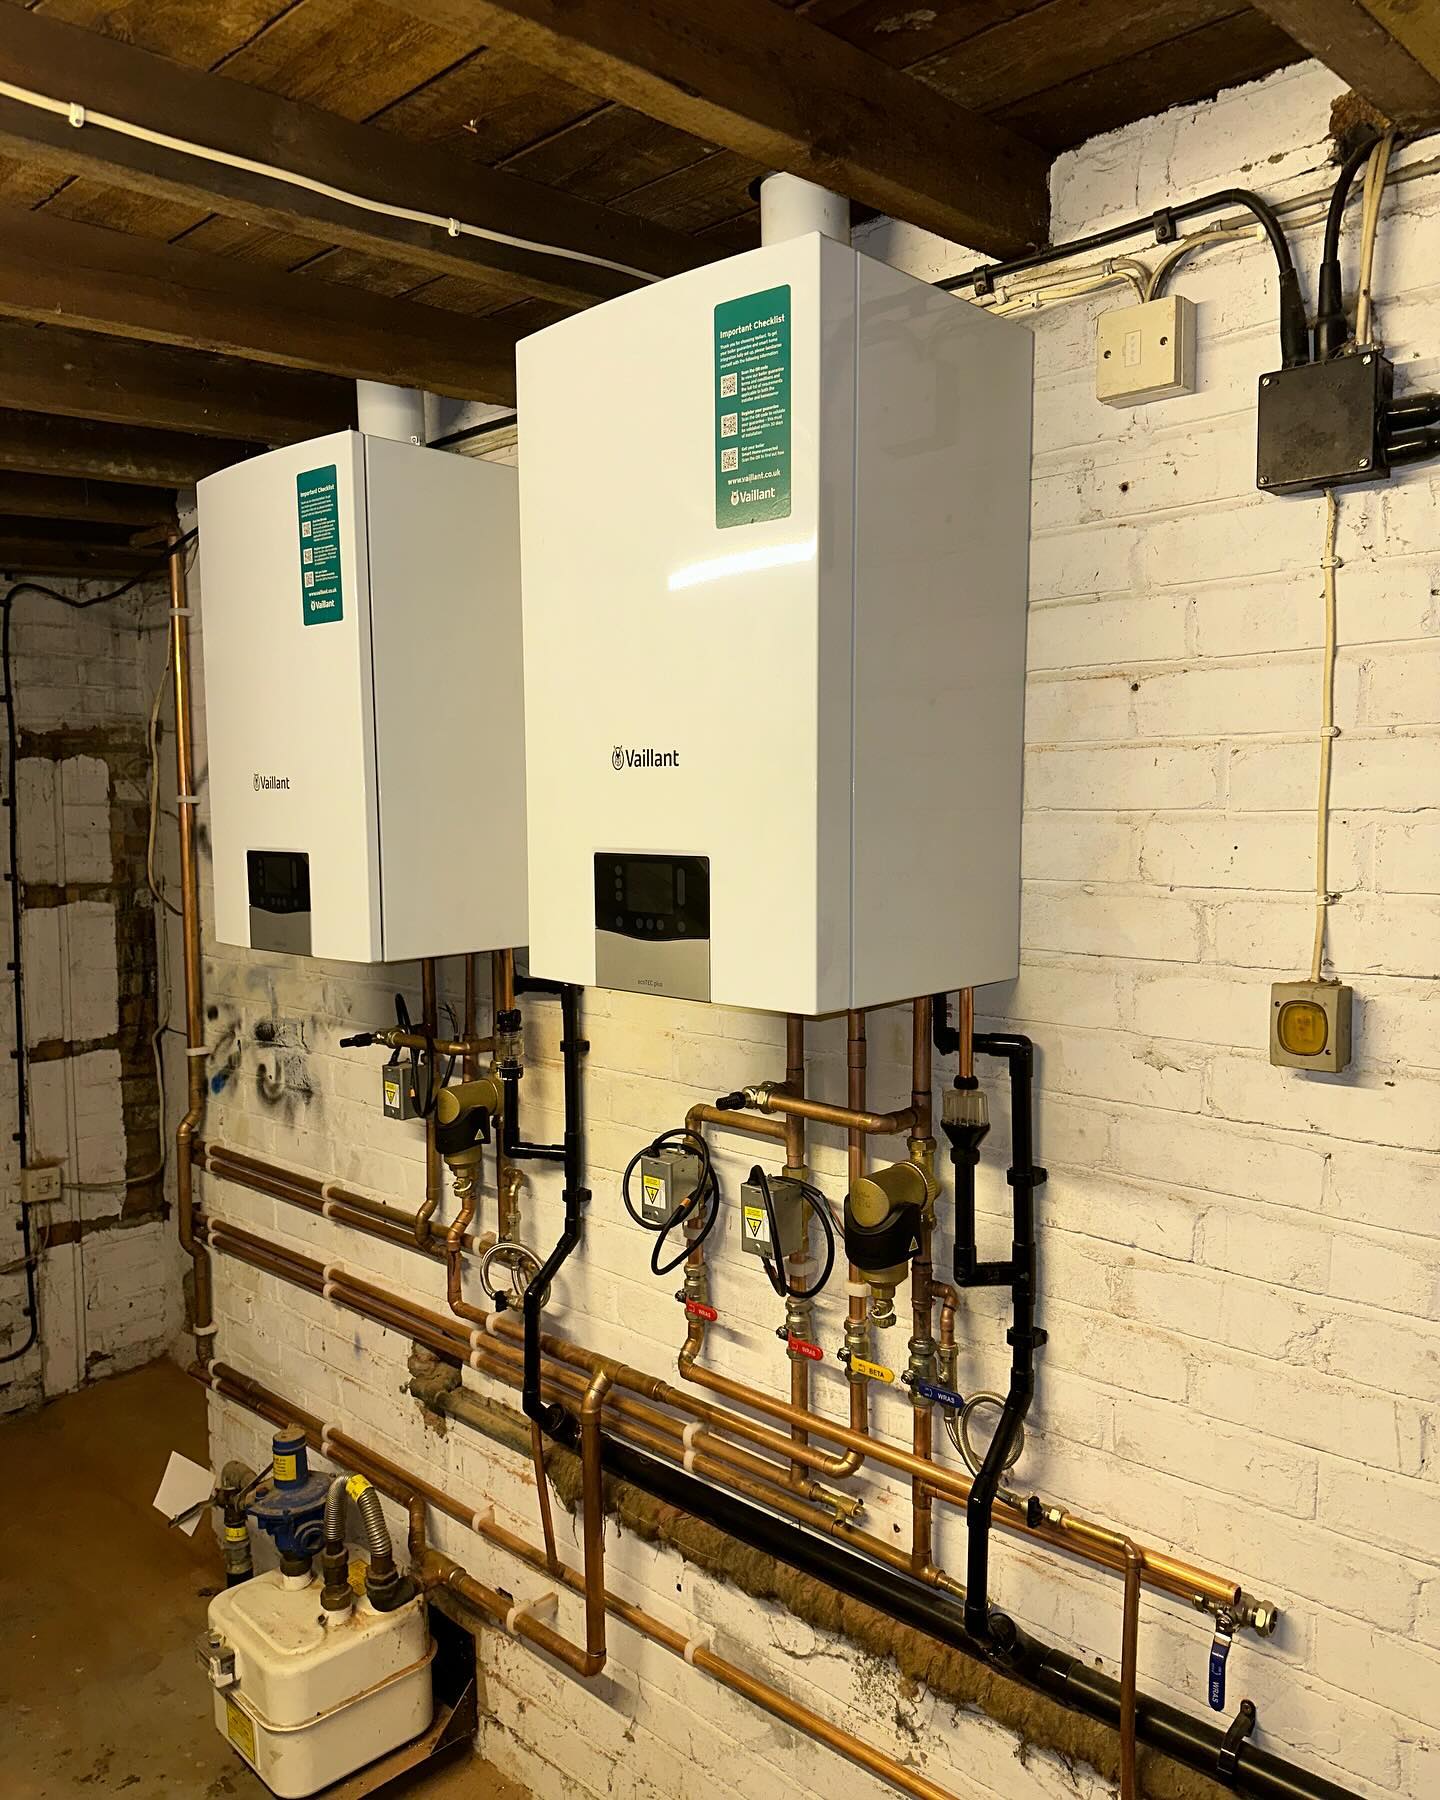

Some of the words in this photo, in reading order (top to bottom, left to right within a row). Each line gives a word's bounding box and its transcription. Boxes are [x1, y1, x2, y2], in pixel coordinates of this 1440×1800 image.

[720, 323, 752, 340] Important
[754, 314, 785, 329] Checklist
[728, 469, 781, 485] www.vaillant.co.uk
[740, 487, 775, 502] Vaillant
[316, 600, 335, 609] Vaillant
[625, 748, 680, 768] Vaillant
[260, 775, 291, 789] Vaillant
[698, 1309, 711, 1318] WRAS
[801, 1347, 816, 1357] WRAS
[869, 1367, 885, 1378] BETA
[938, 1393, 955, 1404] WRAS
[1212, 1681, 1220, 1704] WRAS
